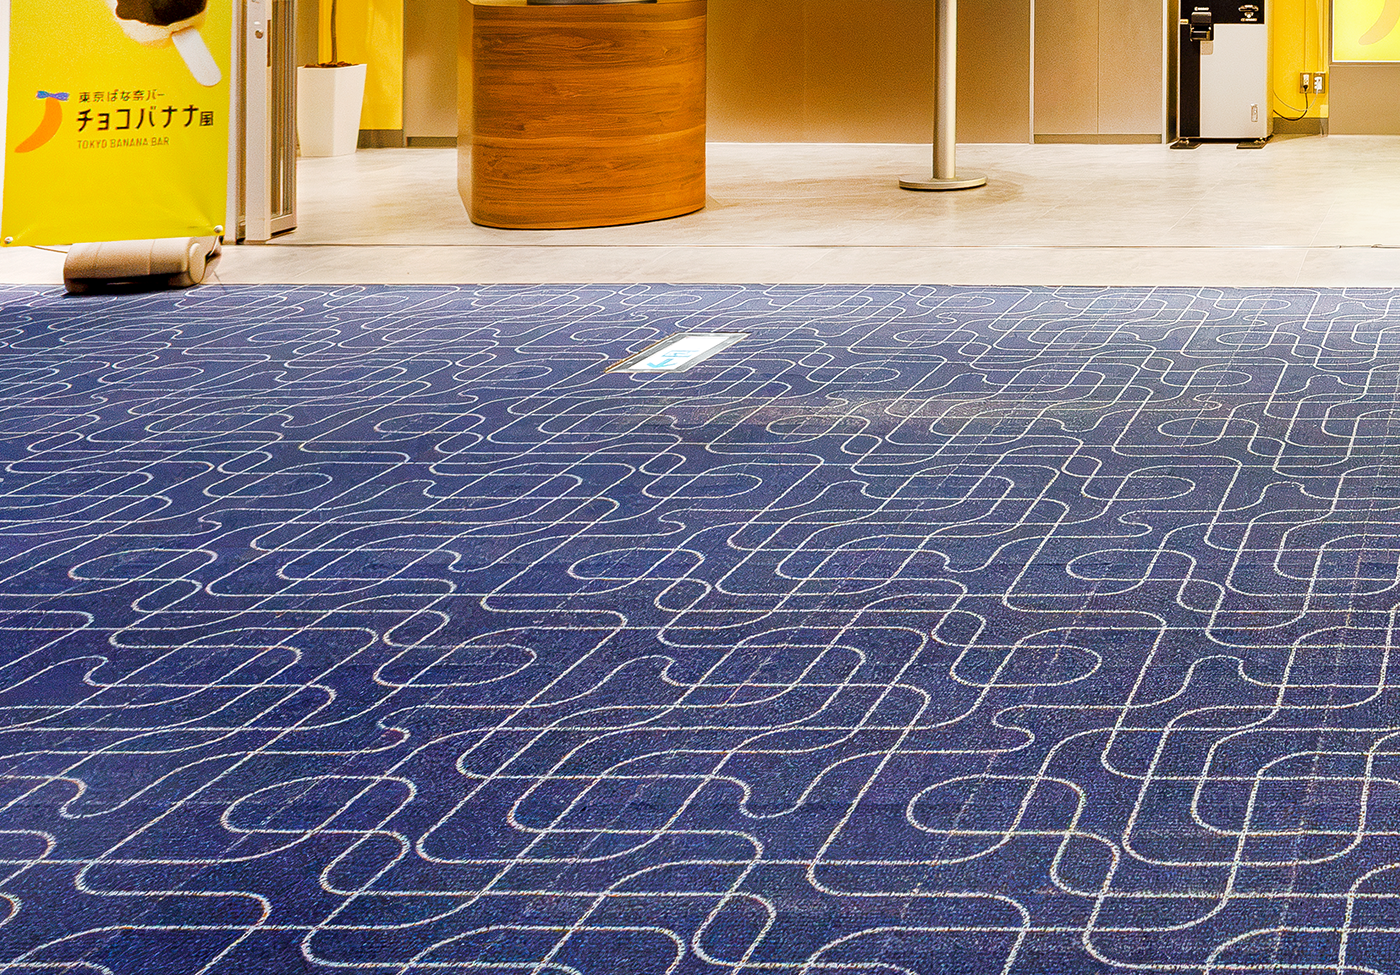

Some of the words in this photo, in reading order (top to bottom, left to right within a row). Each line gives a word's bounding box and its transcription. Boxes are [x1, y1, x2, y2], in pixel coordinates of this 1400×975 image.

[78, 89, 166, 103] 東京ばな奈バー
[77, 139, 108, 150] TOKYO
[110, 137, 149, 149] BANANA
[150, 136, 170, 147] BAR
